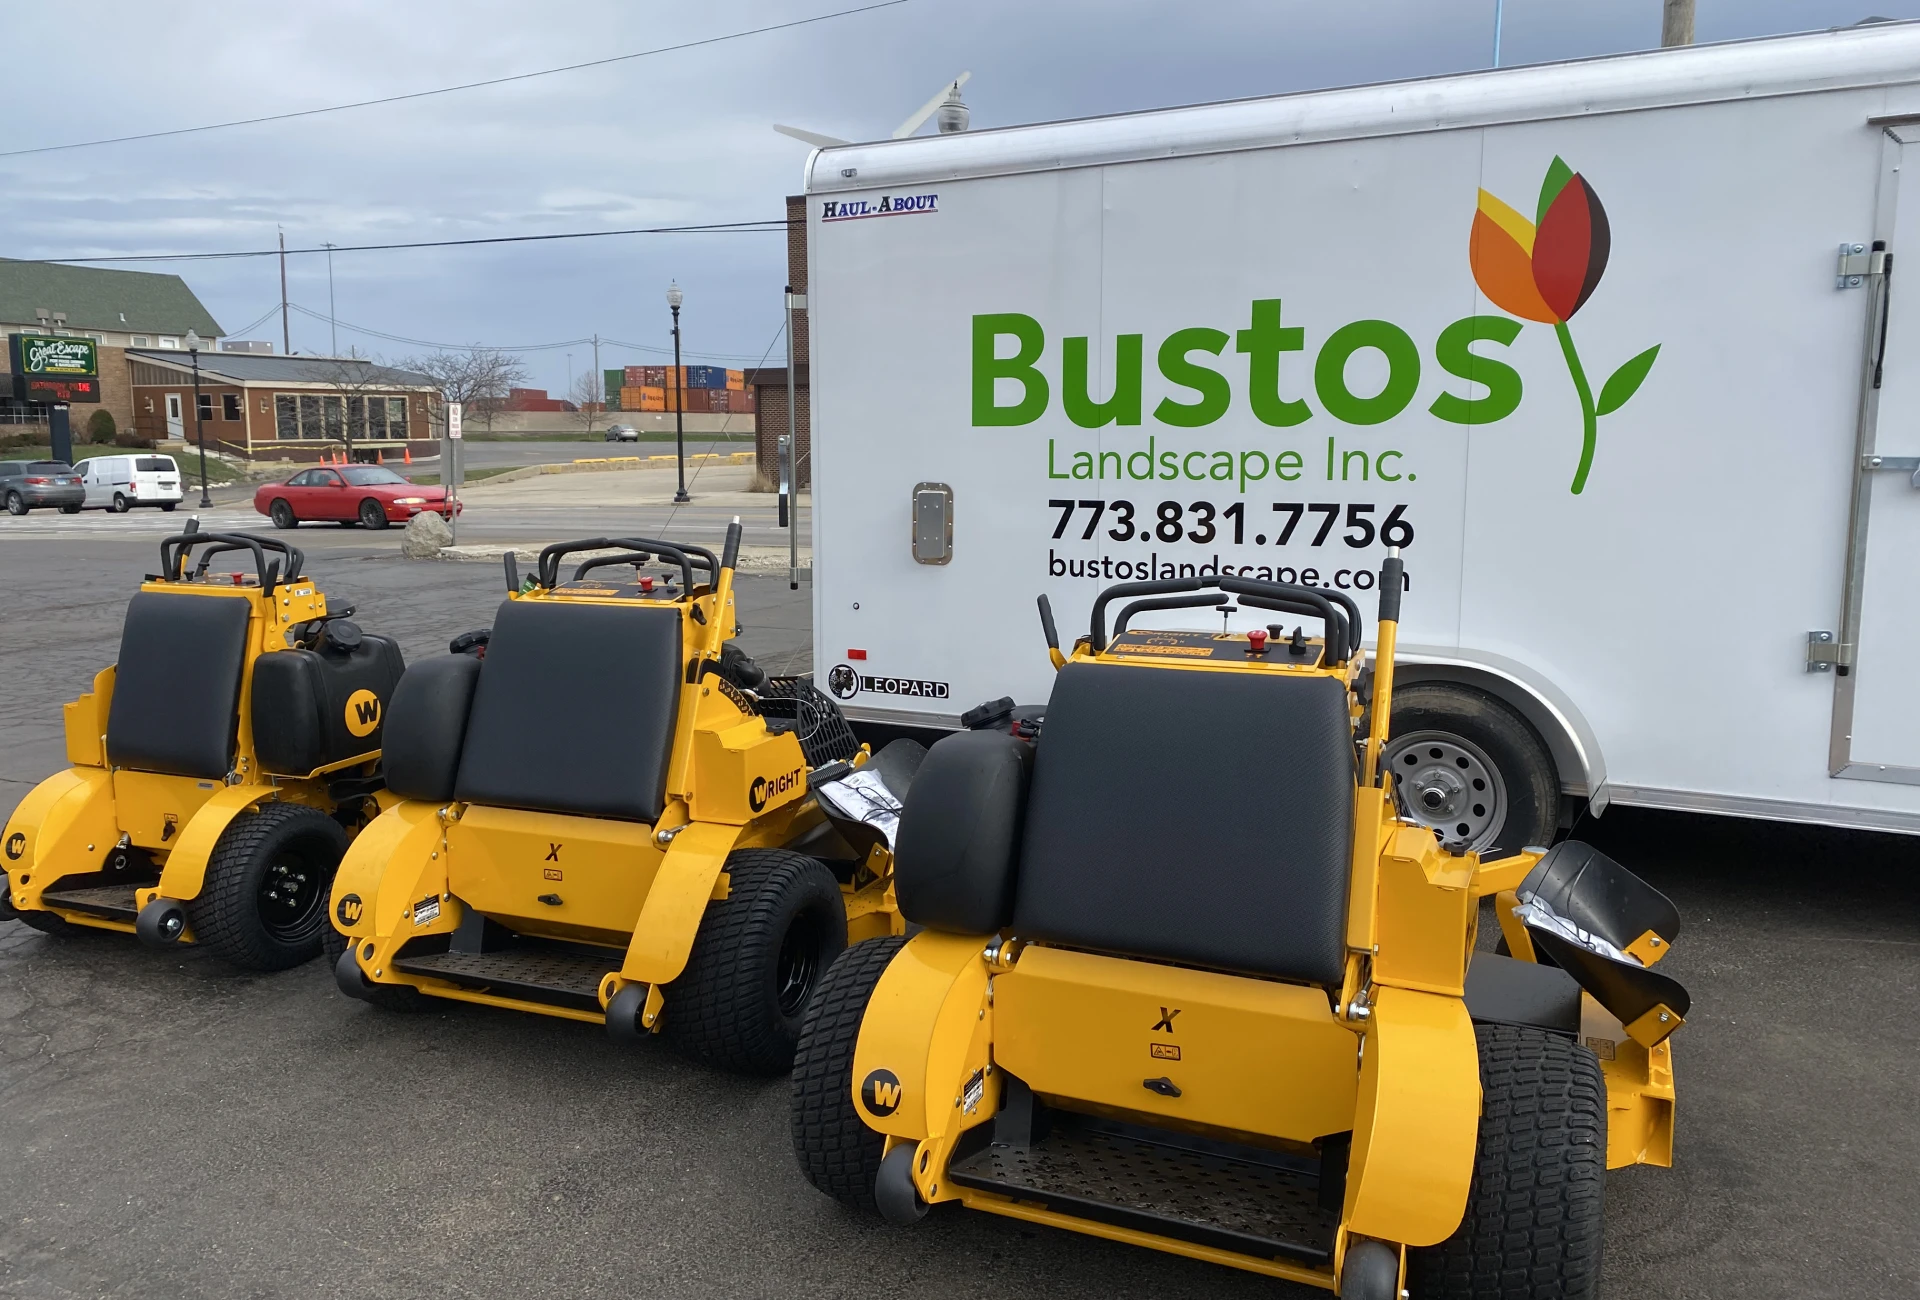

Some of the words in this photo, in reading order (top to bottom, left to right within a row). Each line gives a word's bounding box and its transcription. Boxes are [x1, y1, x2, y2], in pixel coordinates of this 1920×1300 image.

[822, 194, 938, 218] HAUL-ABOUT
[30, 343, 57, 371] Great
[57, 341, 89, 358] Escape
[972, 299, 1524, 428] Bustos
[1048, 436, 1303, 493] Landscape
[1327, 437, 1417, 481] Inc.
[1048, 500, 1414, 549] 773.831.7756
[1049, 549, 1409, 591] bustoslandscape.co
[862, 676, 948, 697] LEOPARD
[355, 698, 378, 725] W
[751, 767, 801, 807] WRIGHT
[545, 842, 563, 862] X
[1151, 1006, 1181, 1034] X
[874, 1080, 901, 1108] W
